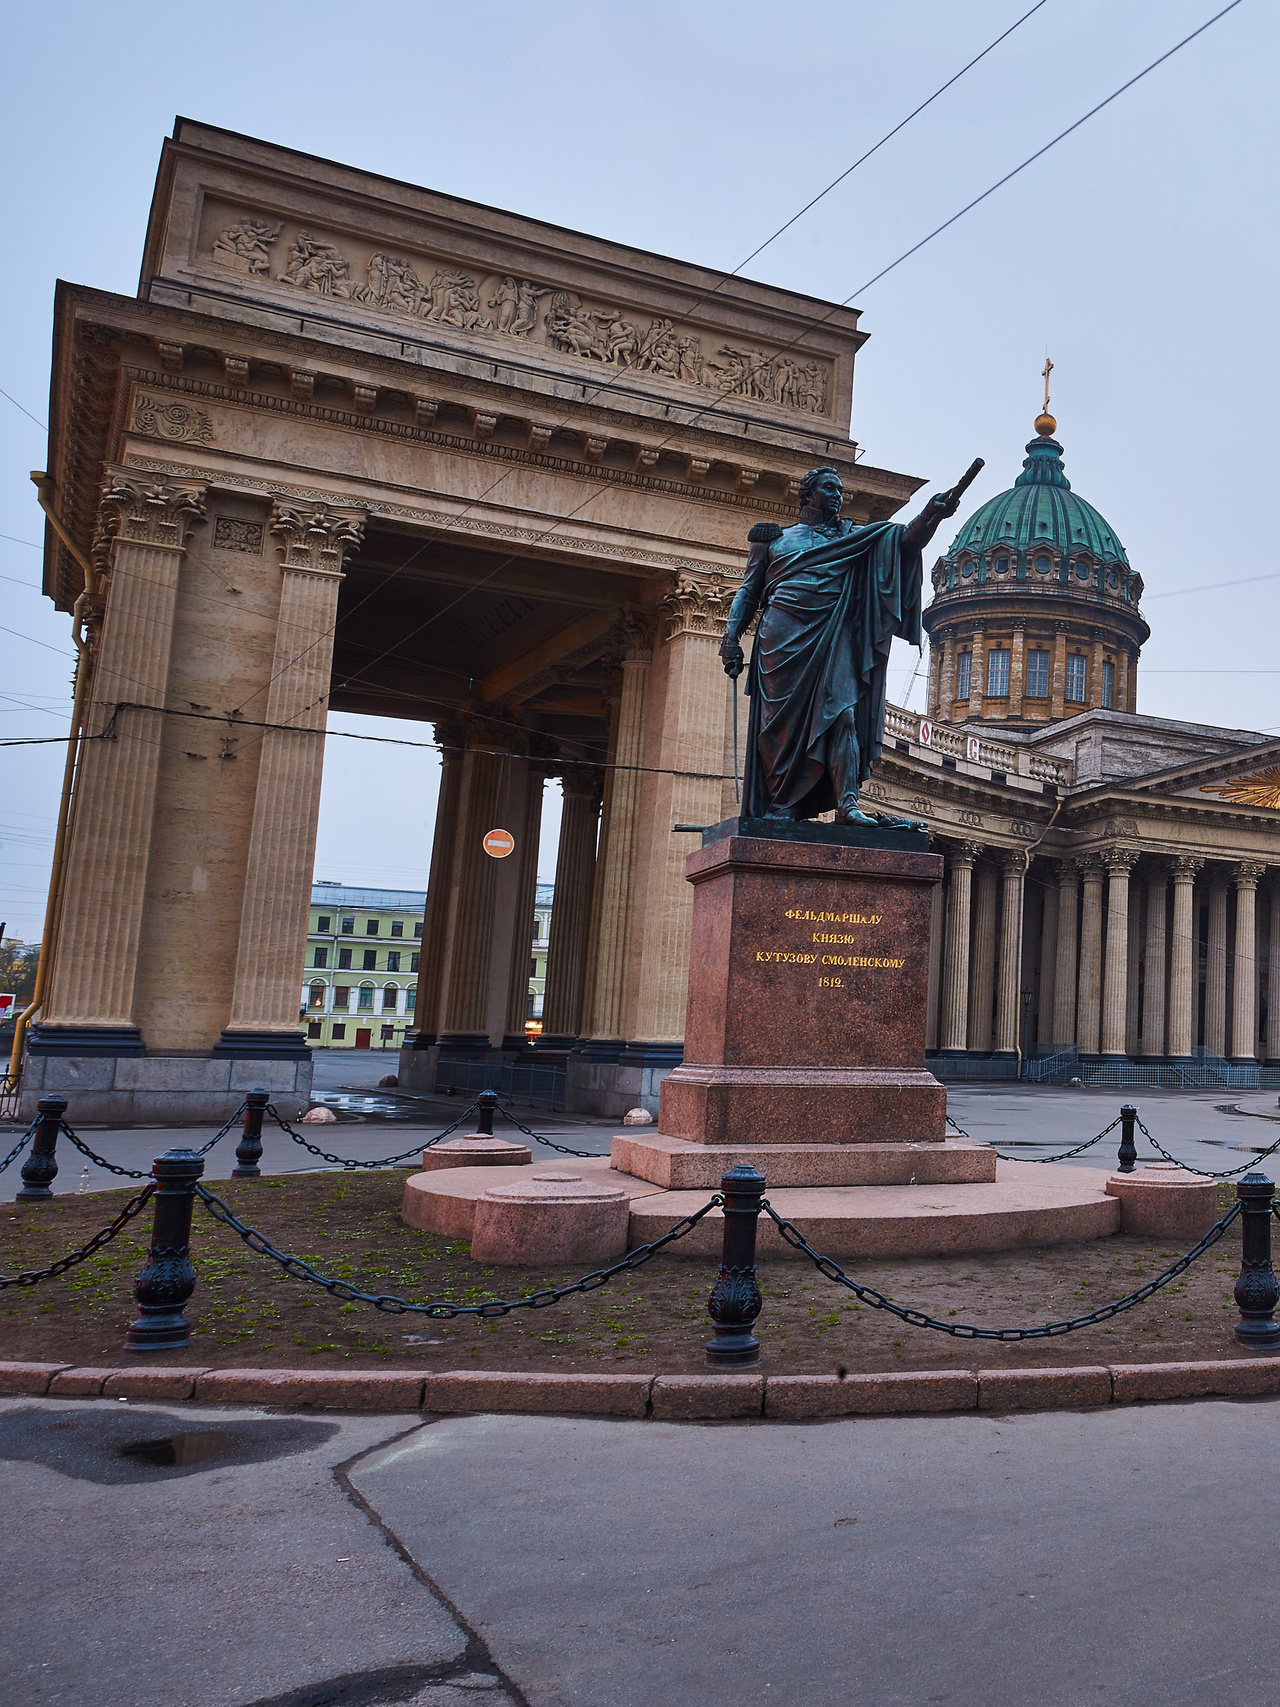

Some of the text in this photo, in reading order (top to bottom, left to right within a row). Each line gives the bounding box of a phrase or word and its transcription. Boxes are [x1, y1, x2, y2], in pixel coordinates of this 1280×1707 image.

[784, 909, 883, 925] ФЕЛЬДМАРШАЛУ
[812, 932, 855, 945] КНЯЗЮ
[755, 951, 906, 969] КУТУЗОВУ СМОЛЕНСКОМУ
[818, 976, 845, 988] 1812.
